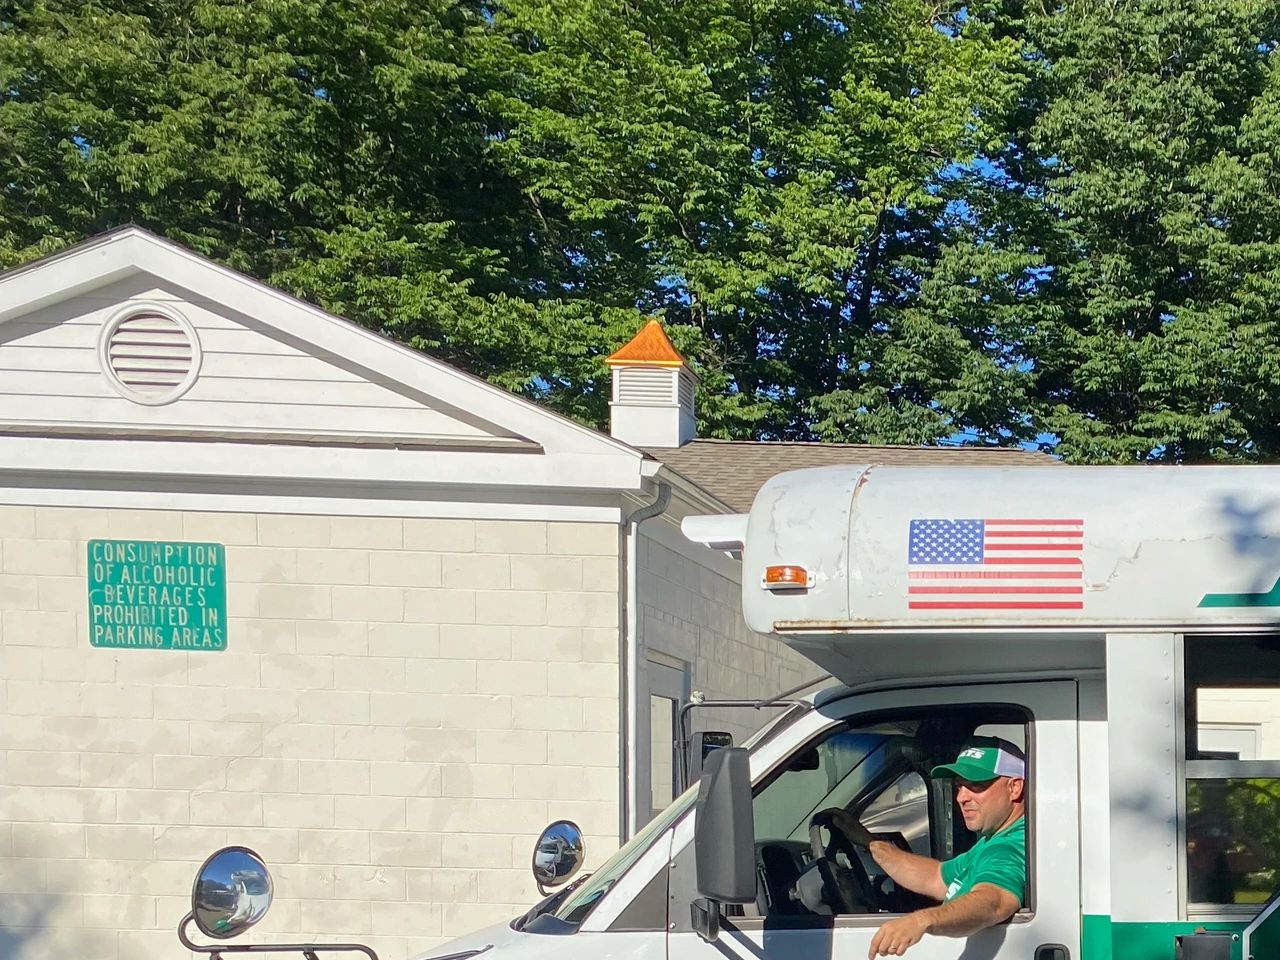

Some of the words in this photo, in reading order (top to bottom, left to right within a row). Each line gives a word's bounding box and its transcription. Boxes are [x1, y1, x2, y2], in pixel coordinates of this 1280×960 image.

[93, 543, 216, 566] CONSUMPTION
[94, 563, 114, 583] OF
[121, 565, 216, 587] ALCOHOLIC
[105, 584, 206, 607] BEVERAGES
[93, 604, 188, 626] PROHIBITED
[202, 607, 218, 628] IN
[95, 625, 163, 646] PARKING
[171, 627, 222, 648] AREAS
